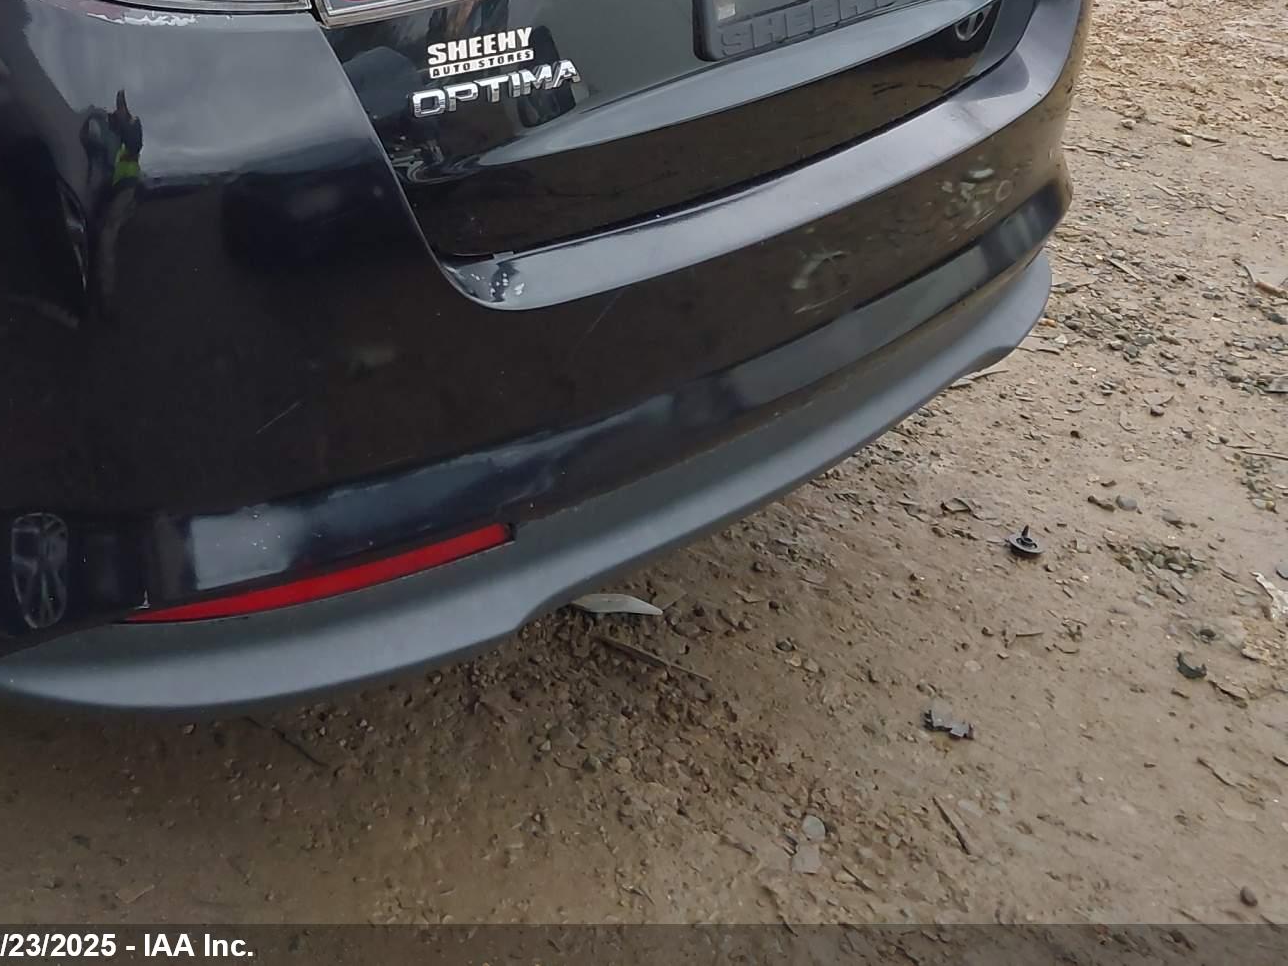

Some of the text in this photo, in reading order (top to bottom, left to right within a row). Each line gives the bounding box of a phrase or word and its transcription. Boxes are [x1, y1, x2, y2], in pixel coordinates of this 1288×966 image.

[427, 27, 532, 65] SHEEHY
[432, 50, 530, 77] AUTO STORES
[412, 59, 581, 118] OPTIMA
